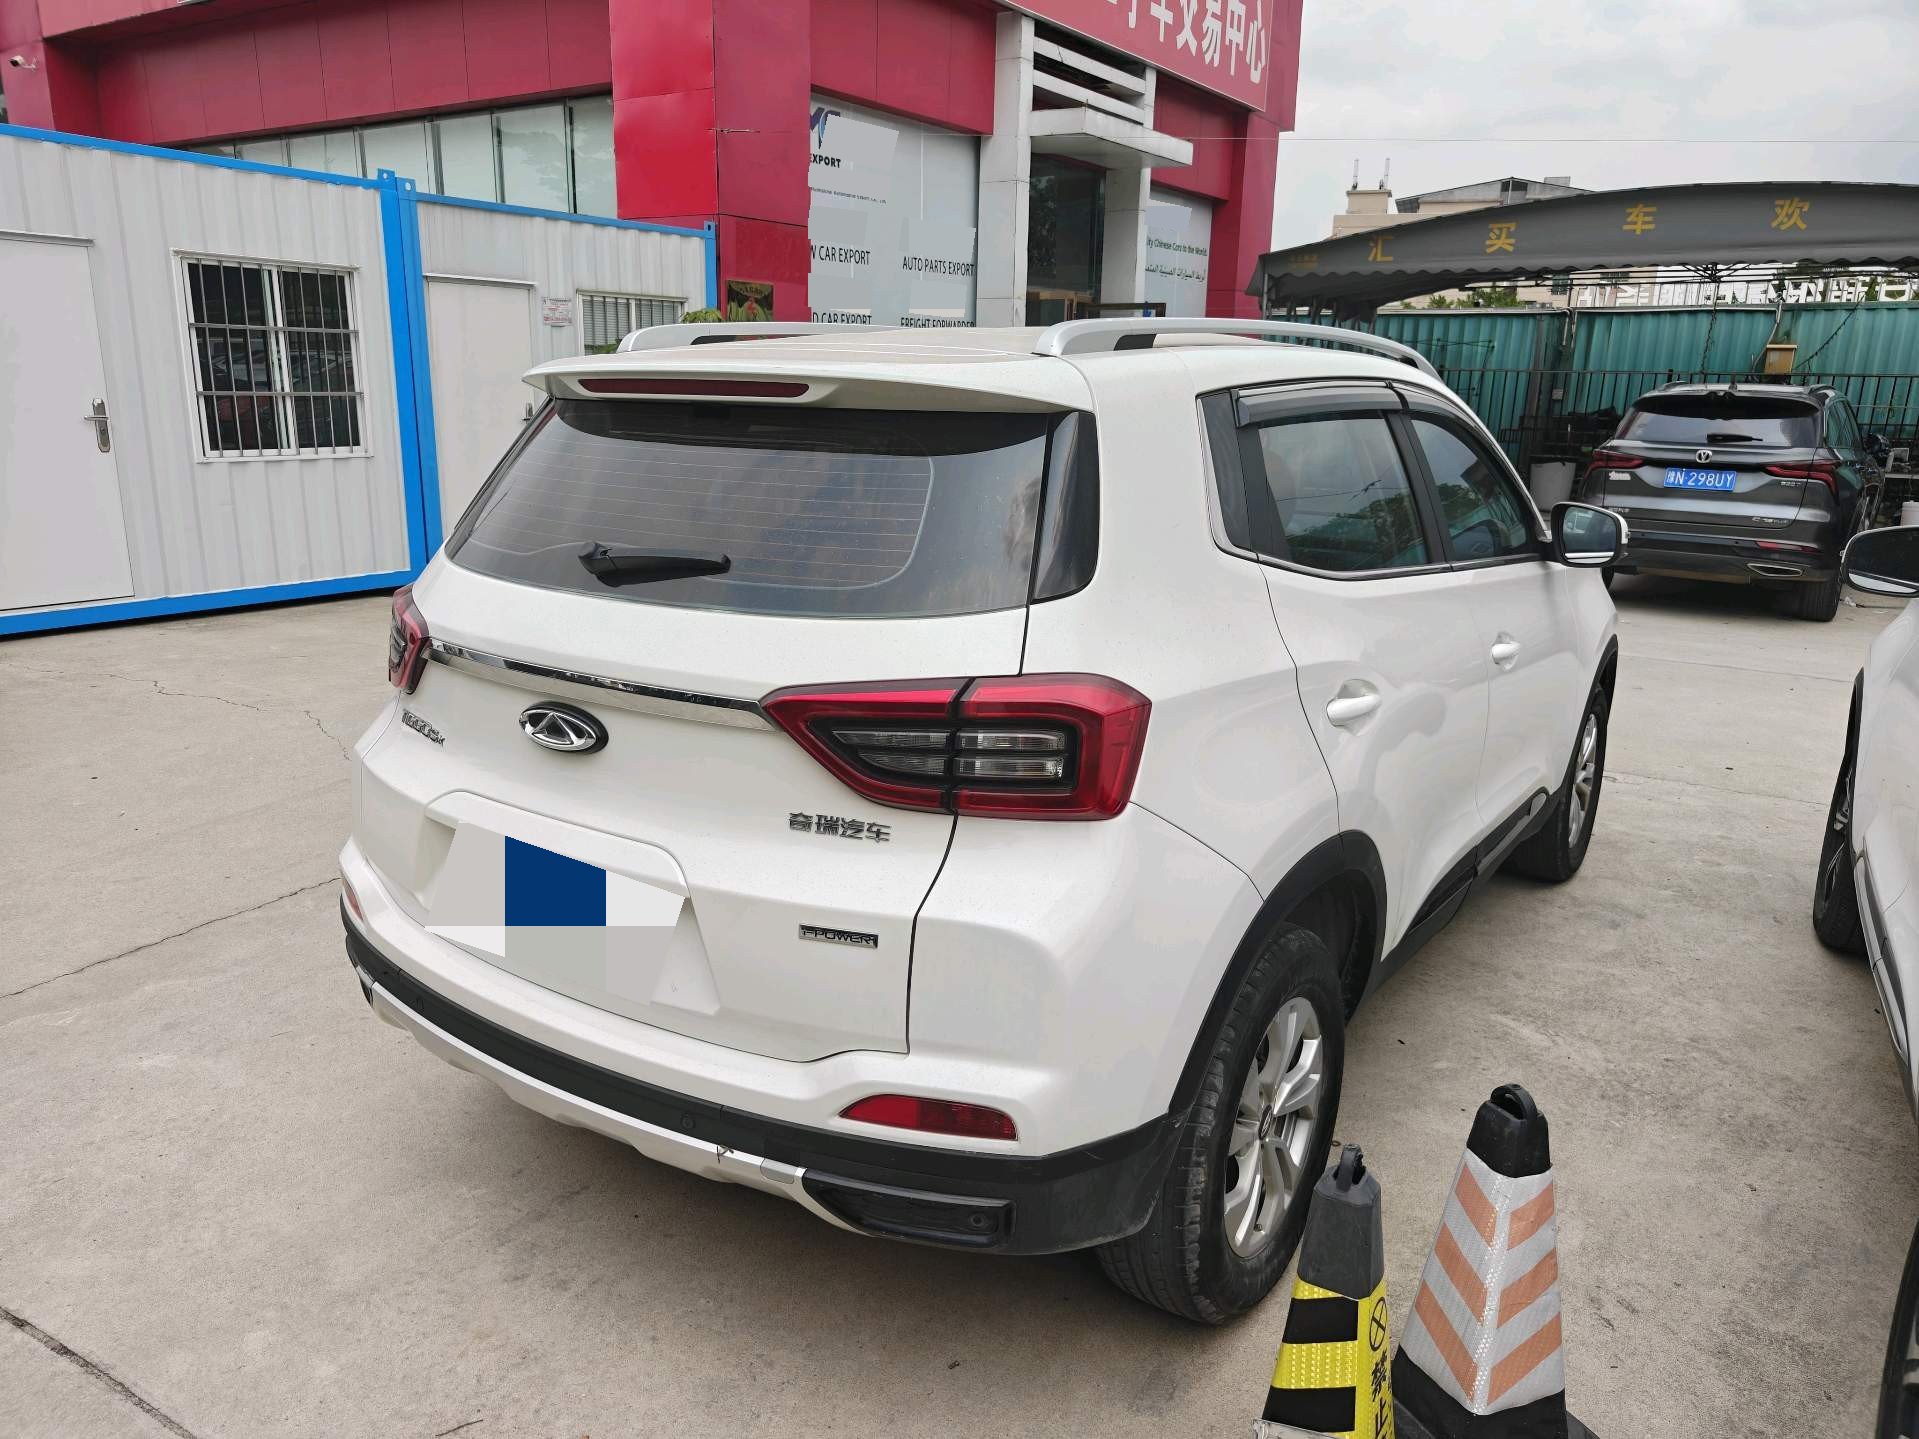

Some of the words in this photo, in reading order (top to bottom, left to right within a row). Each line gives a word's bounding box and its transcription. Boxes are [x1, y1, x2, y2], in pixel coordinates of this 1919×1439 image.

[819, 245, 837, 262] CAR
[838, 248, 871, 265] EXPORT
[902, 256, 923, 272] AUTO
[924, 258, 947, 275] PARTS
[948, 261, 976, 277] EXPORT
[788, 812, 892, 843] 奇瑞汽车
